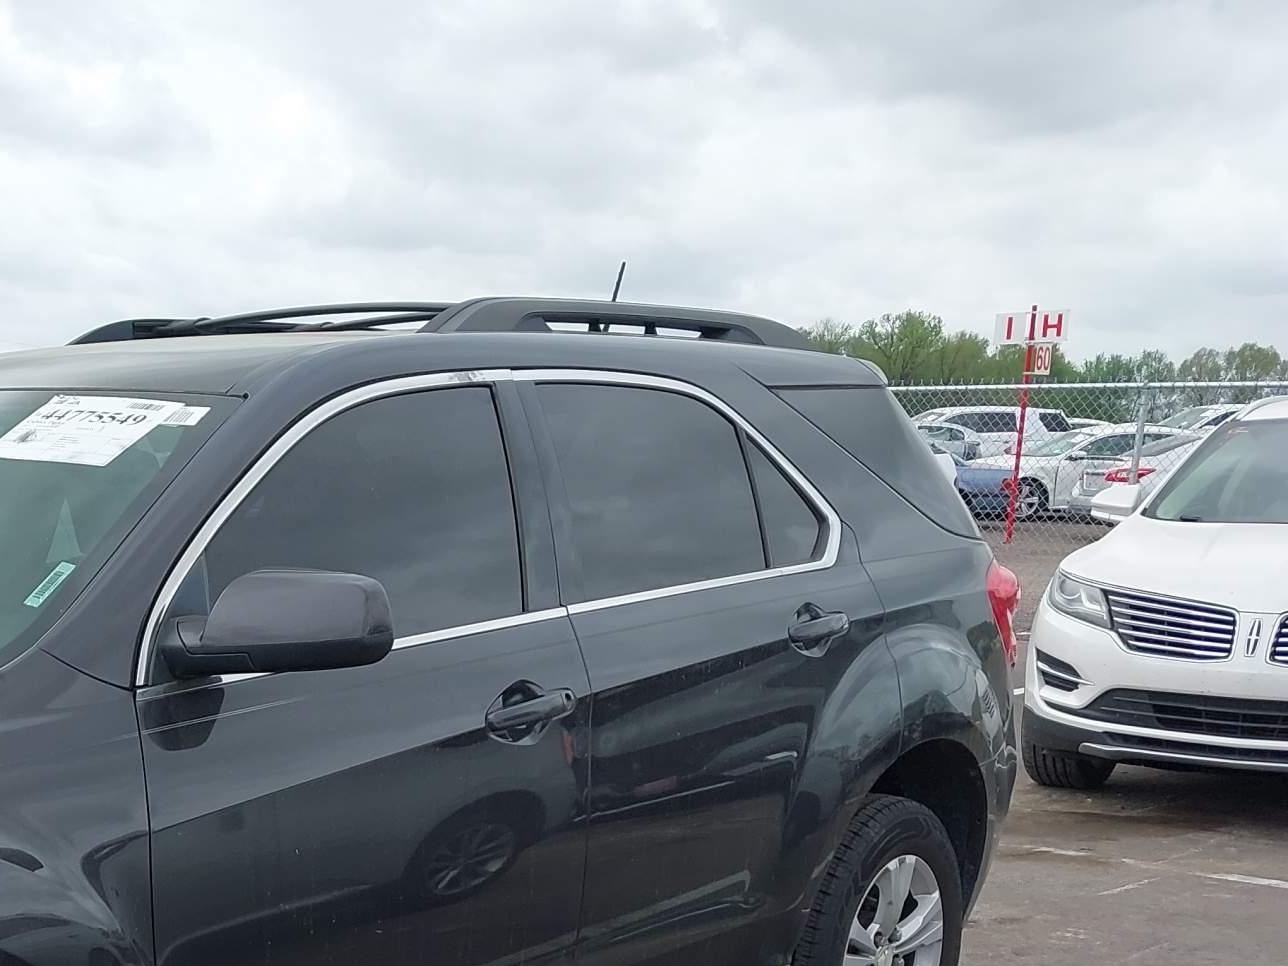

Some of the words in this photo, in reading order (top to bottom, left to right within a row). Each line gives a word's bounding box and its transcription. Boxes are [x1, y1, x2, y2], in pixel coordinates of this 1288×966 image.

[1042, 313, 1064, 337] H
[1036, 346, 1051, 371] 60
[41, 408, 148, 426] 44775549
